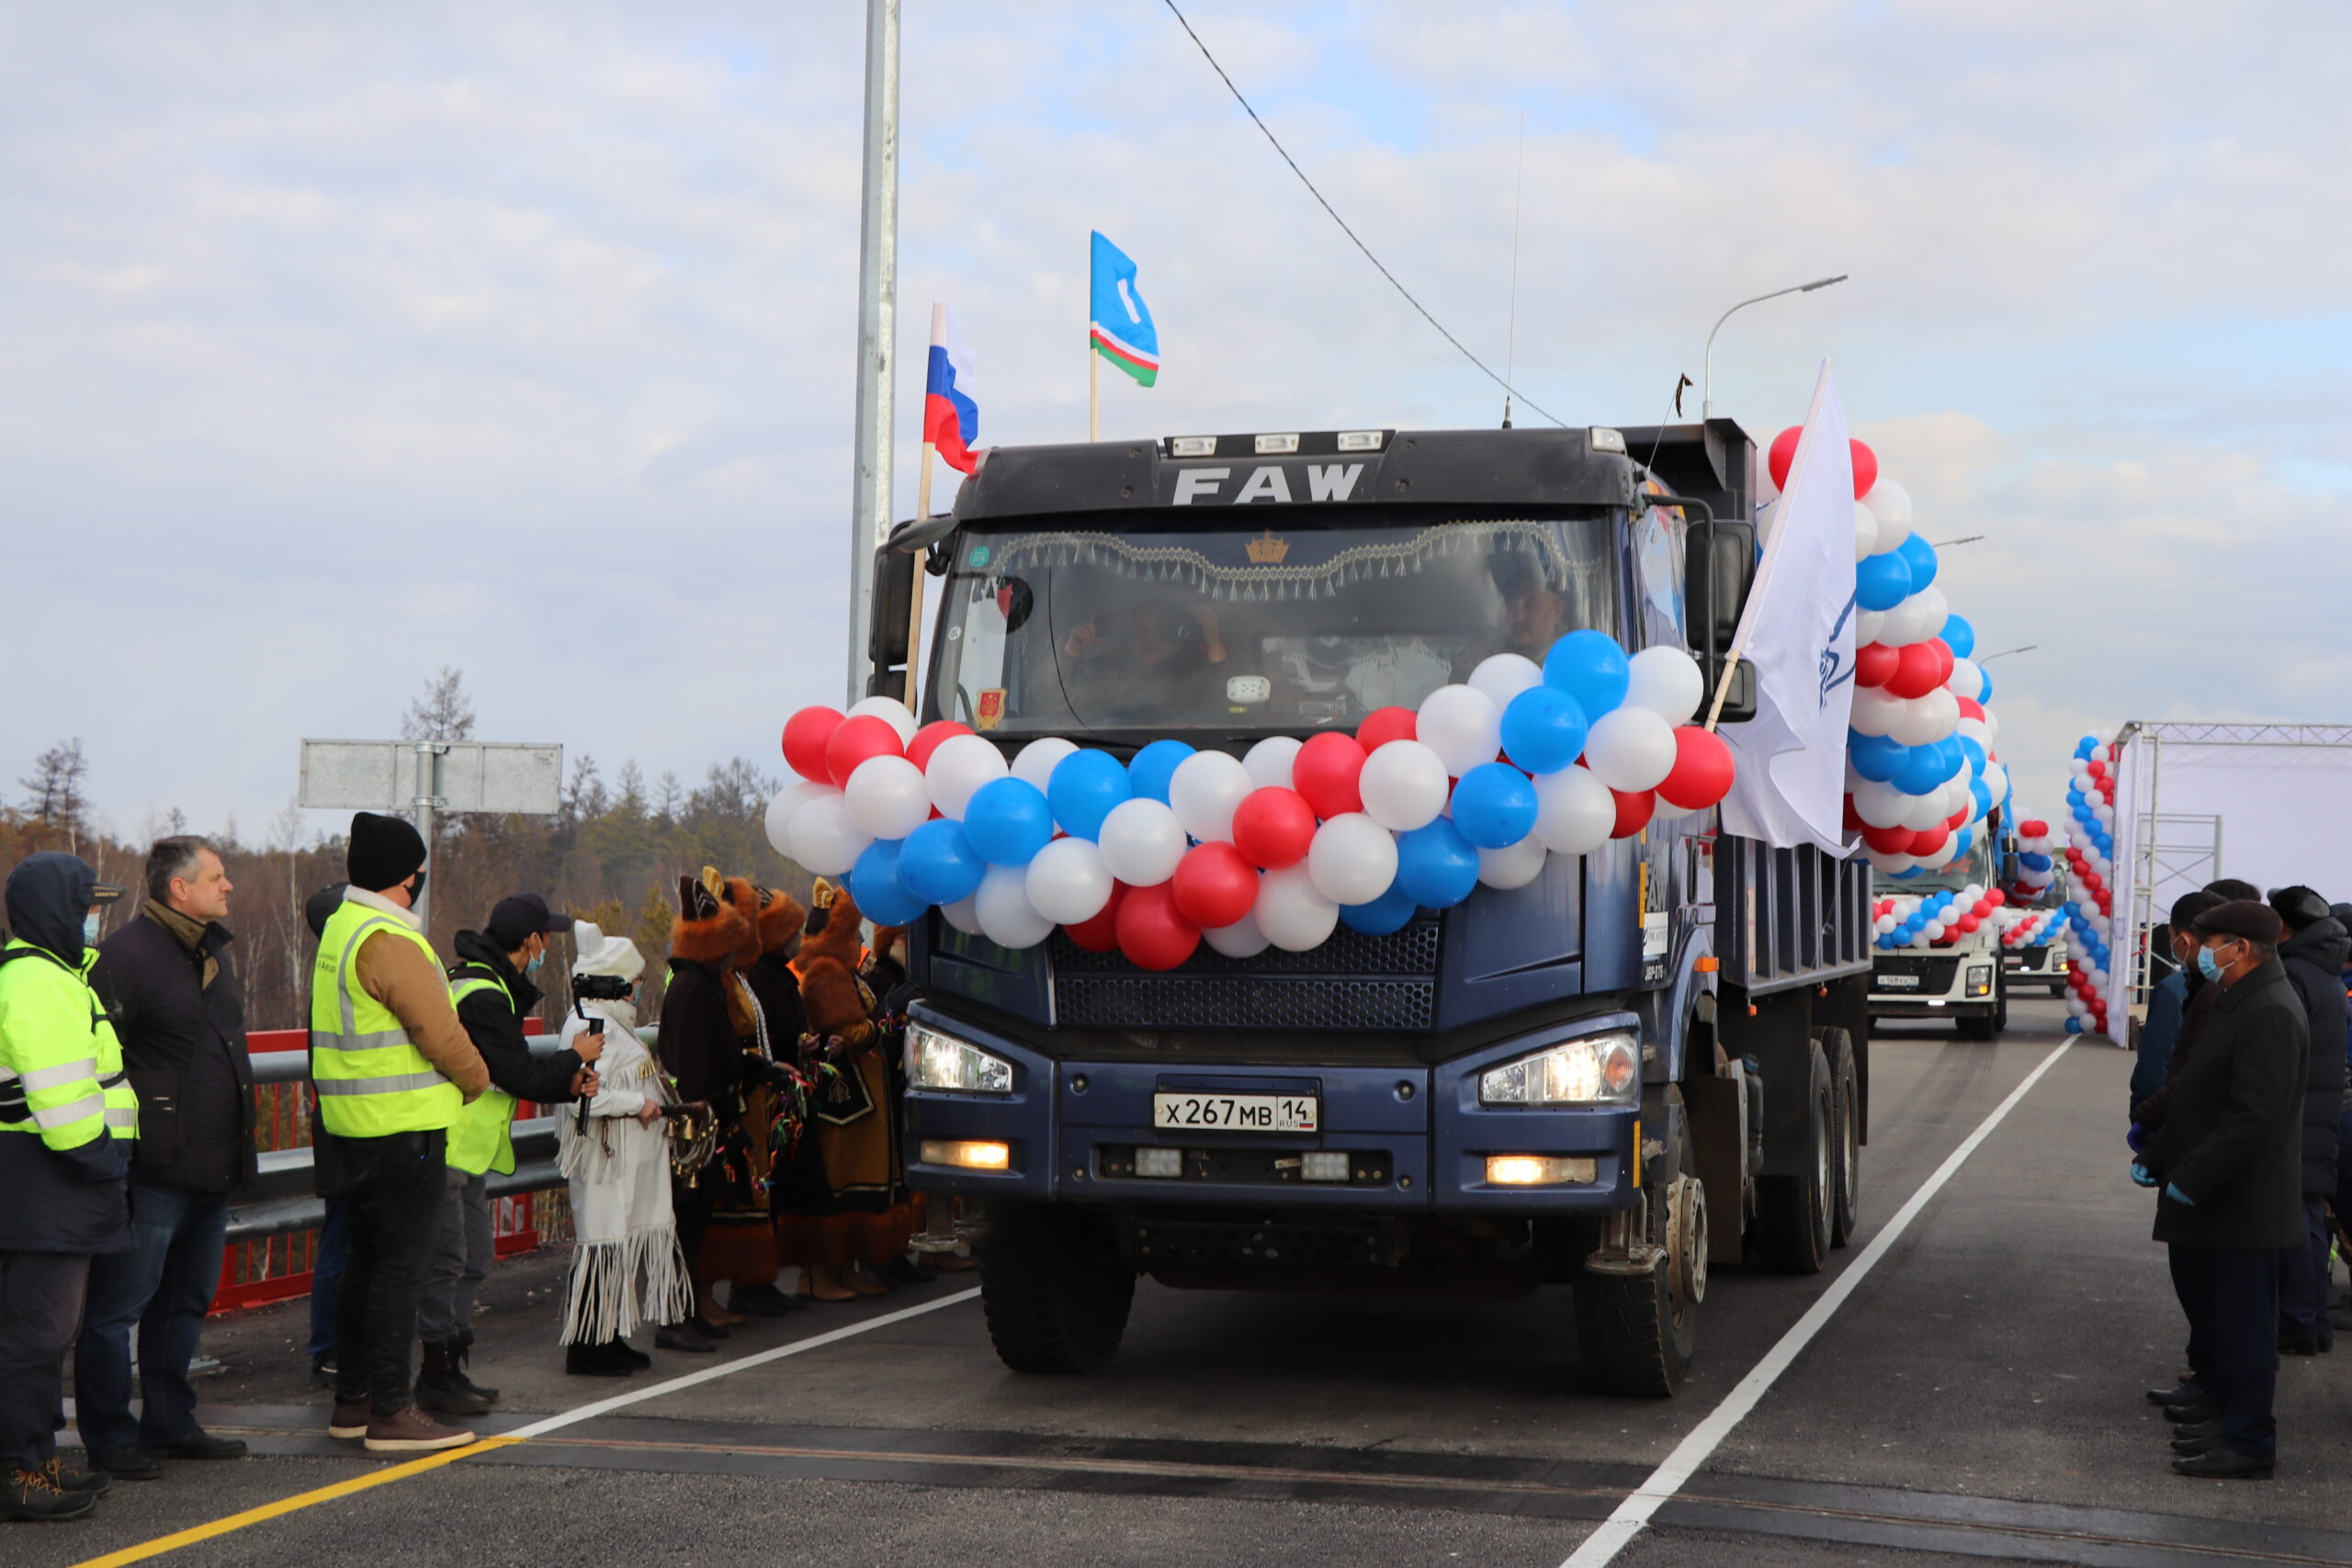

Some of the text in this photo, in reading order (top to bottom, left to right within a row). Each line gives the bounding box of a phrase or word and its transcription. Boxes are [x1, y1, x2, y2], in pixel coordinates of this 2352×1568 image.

[1172, 463, 1364, 506] FAW
[1282, 1100, 1307, 1121] 14
[1279, 1119, 1299, 1128] RUS
